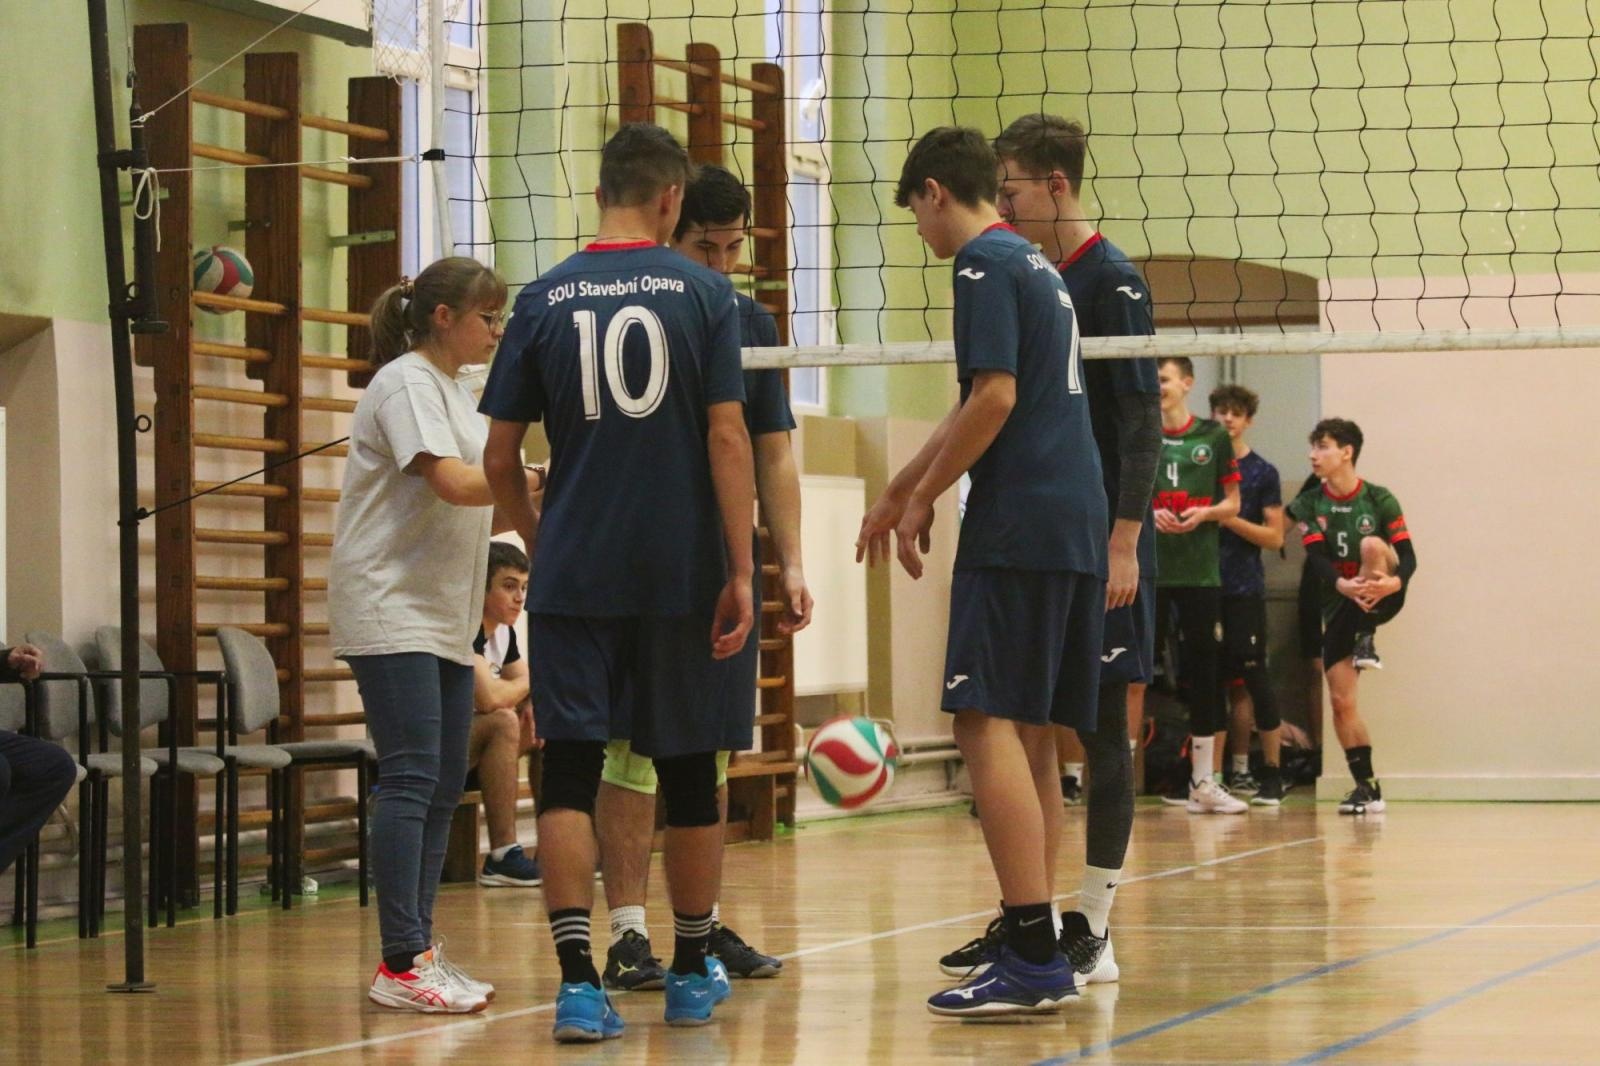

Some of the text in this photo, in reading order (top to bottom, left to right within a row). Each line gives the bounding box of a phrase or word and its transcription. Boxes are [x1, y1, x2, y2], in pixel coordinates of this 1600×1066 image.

[547, 275, 685, 306] SOU Stavební Opava
[572, 305, 670, 420] 10
[1166, 461, 1178, 488] 4
[1337, 531, 1349, 558] 5
